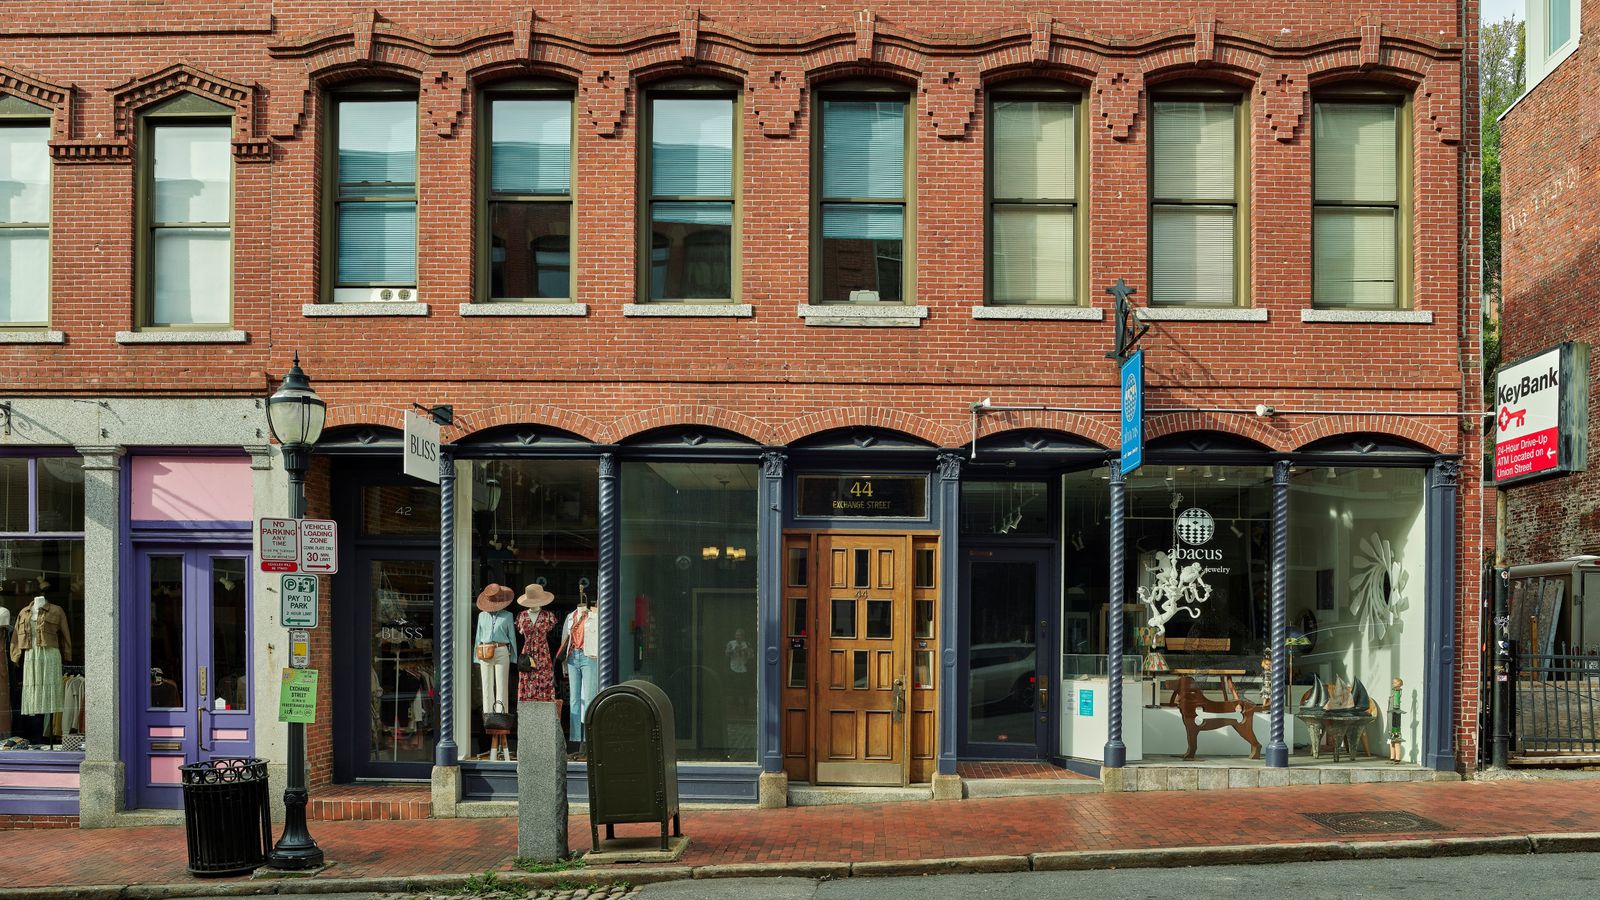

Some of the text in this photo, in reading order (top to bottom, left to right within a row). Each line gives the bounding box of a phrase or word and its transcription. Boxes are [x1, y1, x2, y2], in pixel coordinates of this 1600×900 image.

[1498, 367, 1559, 406] KeyBank
[410, 434, 436, 461] BLISS
[1497, 434, 1548, 456] 24-Hour Drive-Up
[1497, 448, 1544, 467] ATM Located on
[1497, 466, 1513, 478] Union
[1514, 461, 1532, 474] Street
[850, 481, 873, 497] 44
[395, 506, 412, 516] 42
[832, 500, 891, 509] EXCHANGE STREET
[262, 528, 296, 536] PARKING
[306, 552, 319, 562] 30
[1167, 543, 1223, 560] abacus
[1205, 565, 1230, 575] jewelry
[856, 590, 868, 599] 44
[381, 626, 423, 640] BLISS
